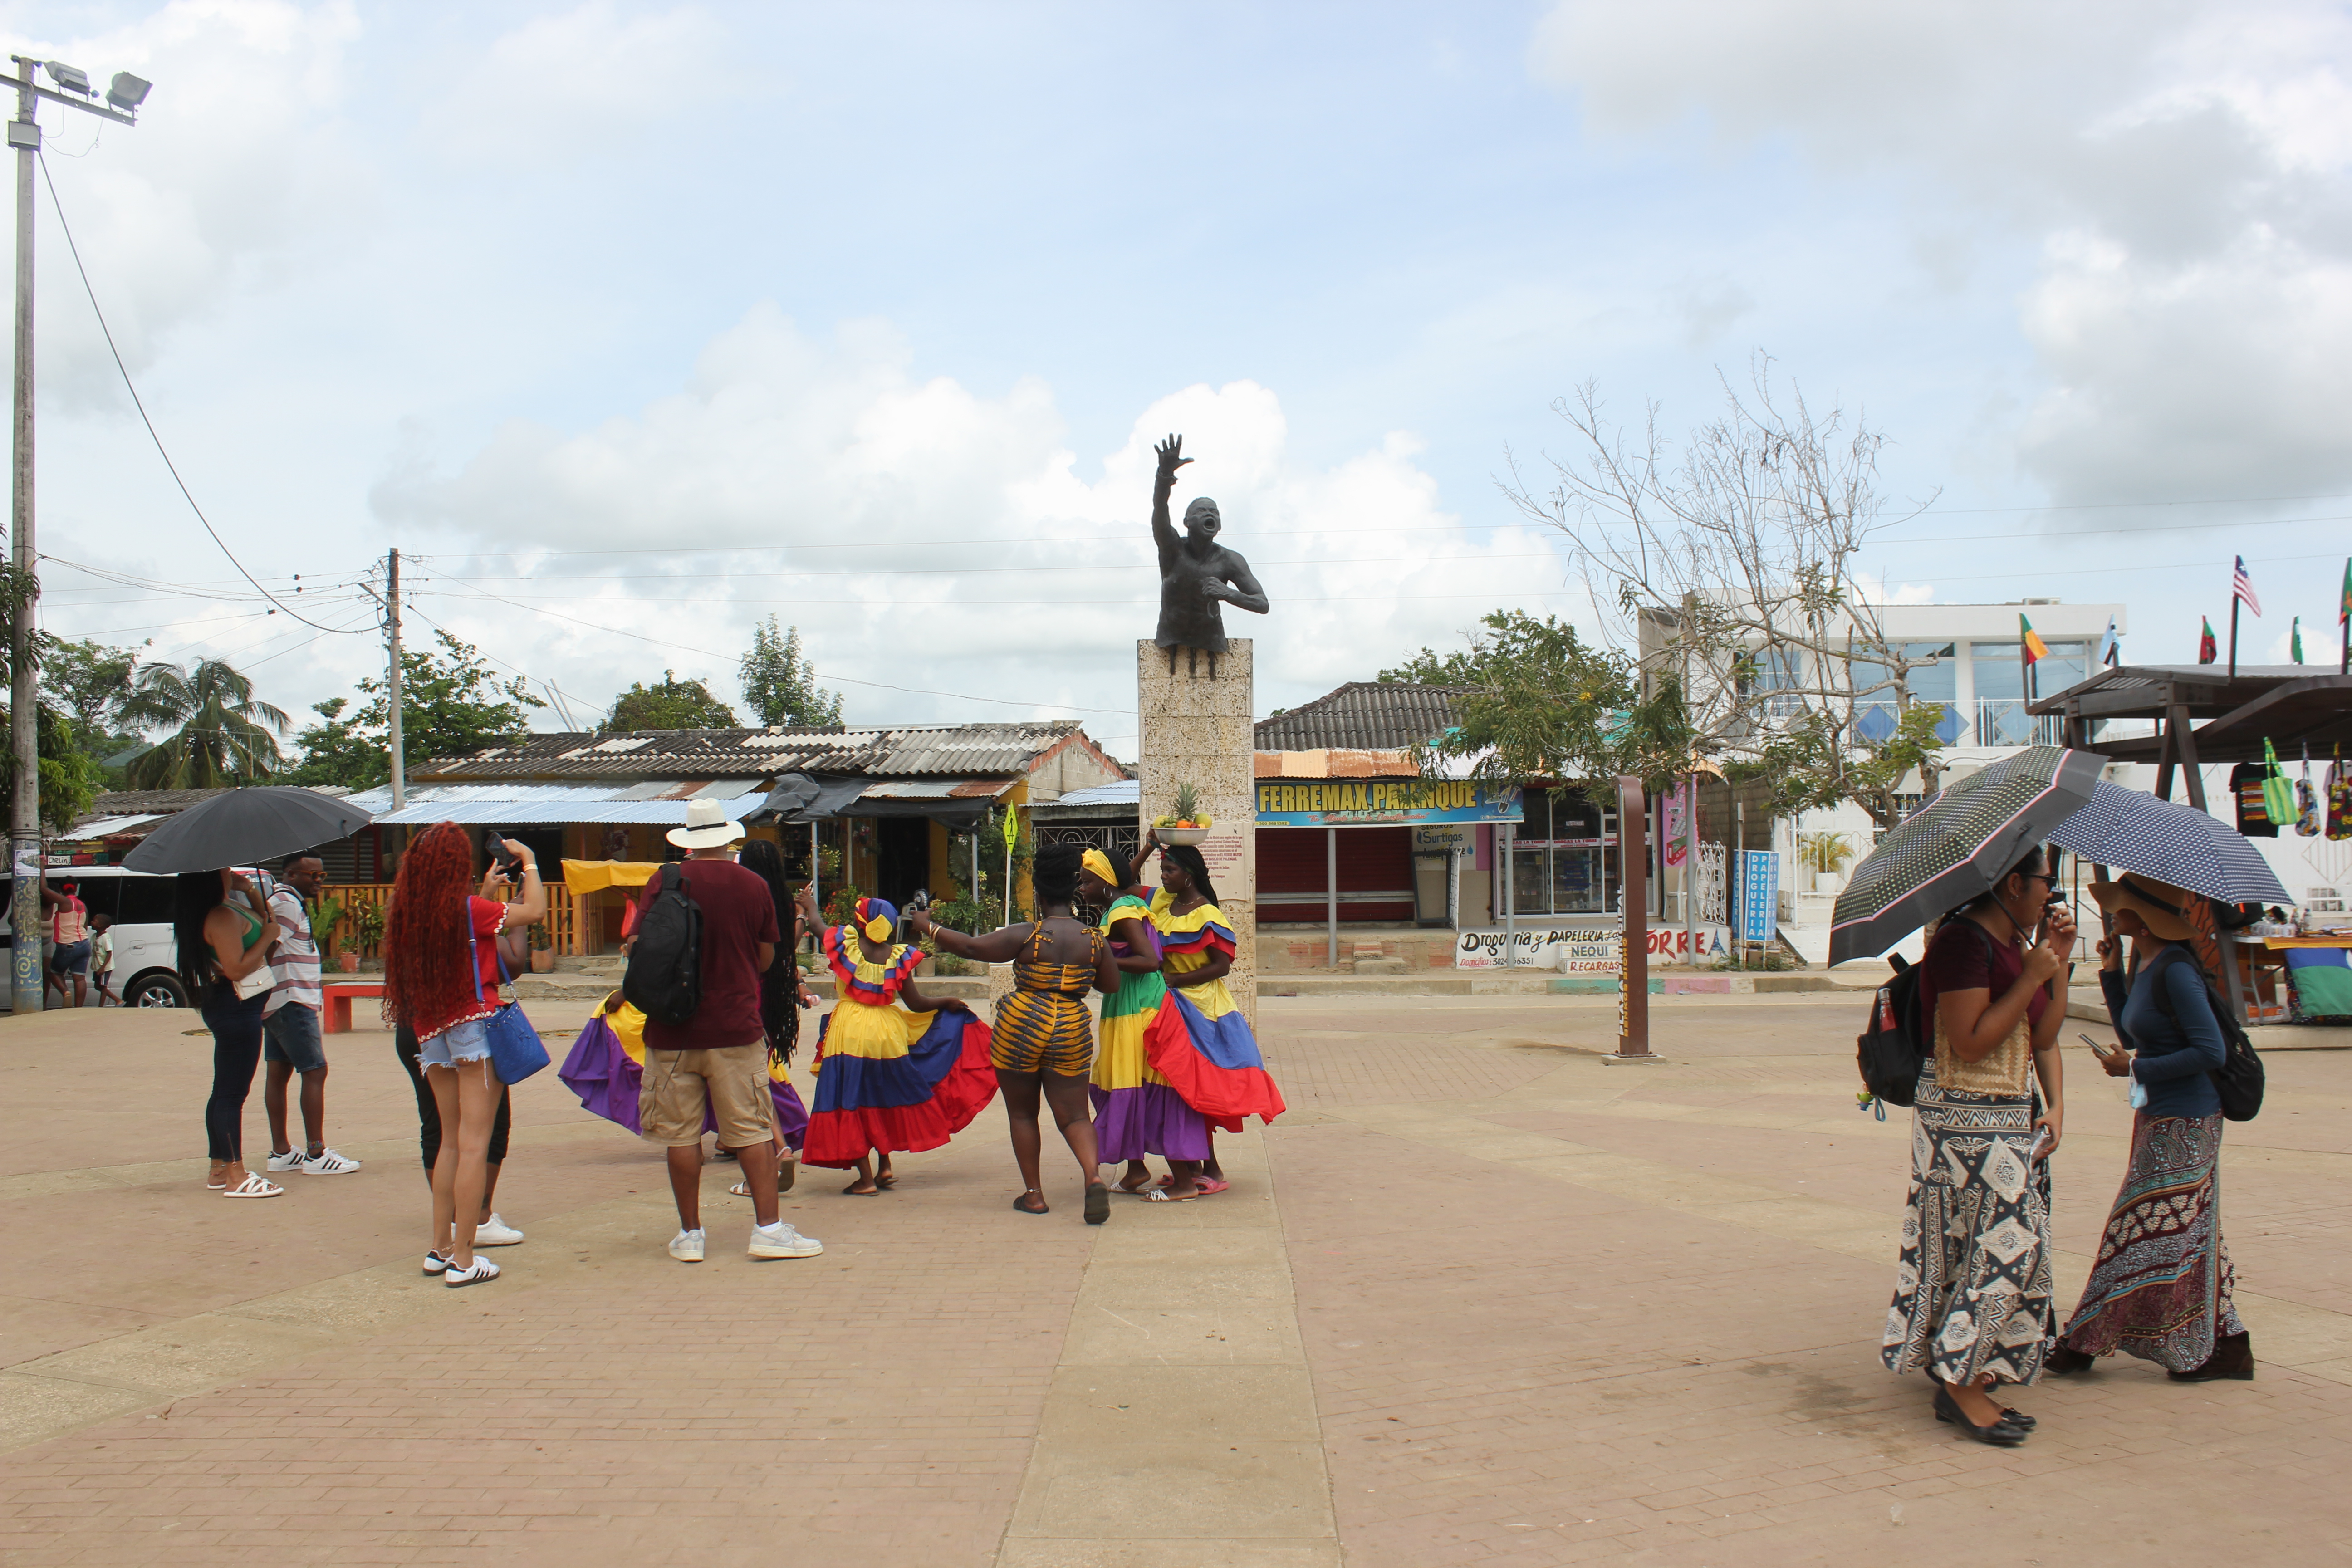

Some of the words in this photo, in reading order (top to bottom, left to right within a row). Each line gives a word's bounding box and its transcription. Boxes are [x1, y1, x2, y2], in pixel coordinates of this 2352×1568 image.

[1259, 784, 1369, 812] FERREMAX
[1423, 831, 1463, 846] Surtigas
[1749, 855, 1759, 936] DROGUERIA
[1757, 855, 1768, 936] PAPELERIA
[1530, 935, 1546, 953] y
[1547, 930, 1603, 946] PAPELERIA
[1647, 929, 1706, 960] ORRE
[1571, 946, 1608, 957] NEQUI
[1570, 961, 1619, 971] RECARGAS
